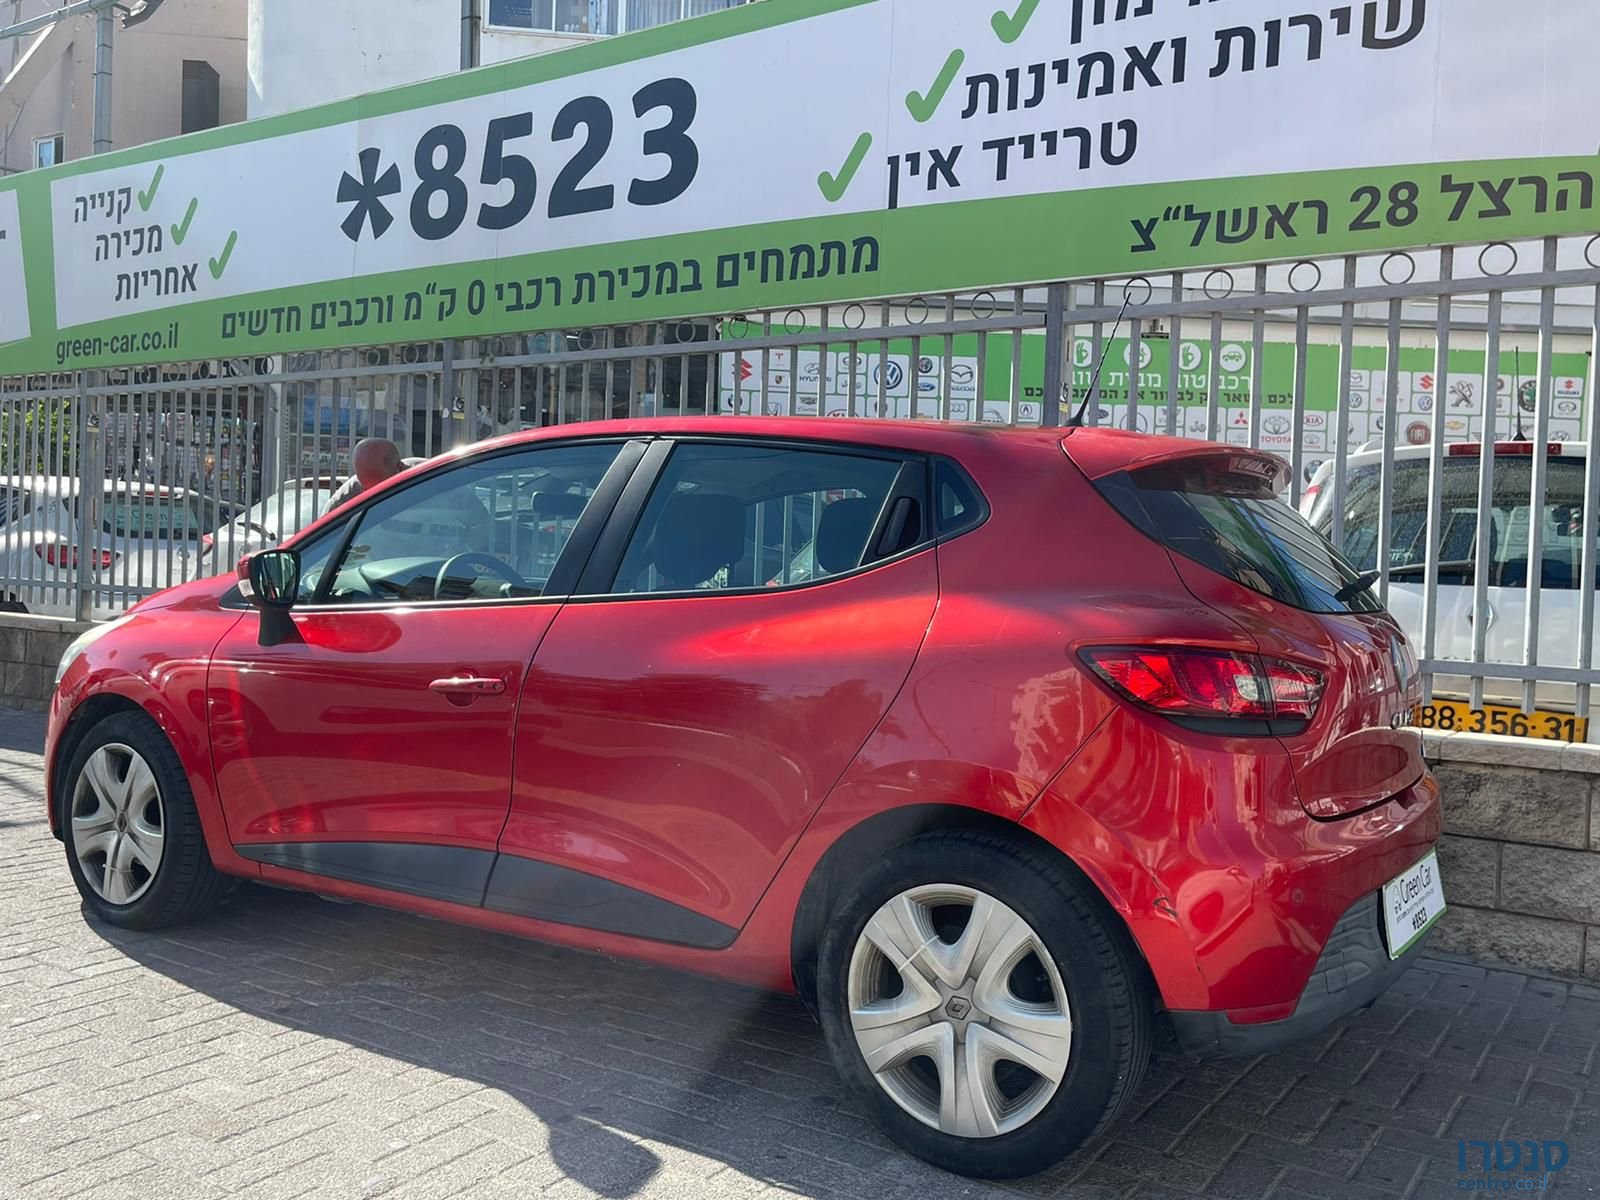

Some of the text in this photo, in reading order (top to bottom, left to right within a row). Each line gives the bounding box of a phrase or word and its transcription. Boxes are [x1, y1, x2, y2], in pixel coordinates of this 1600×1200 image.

[961, 0, 1427, 119] שירות ואמינות
[887, 118, 1138, 210] טרייד אין
[74, 187, 132, 225] קנייה
[1348, 181, 1419, 231] 28
[1440, 170, 1593, 222] הרצל
[95, 224, 163, 262] מכירה
[716, 236, 879, 289] מתמחים
[115, 263, 199, 302] אחריות
[467, 279, 486, 316] 0
[495, 275, 562, 314] רכבי
[571, 258, 703, 305] במכירת
[221, 305, 301, 339] חדשים
[310, 294, 394, 330] ורכבים
[56, 321, 179, 365] green-car.co.il
